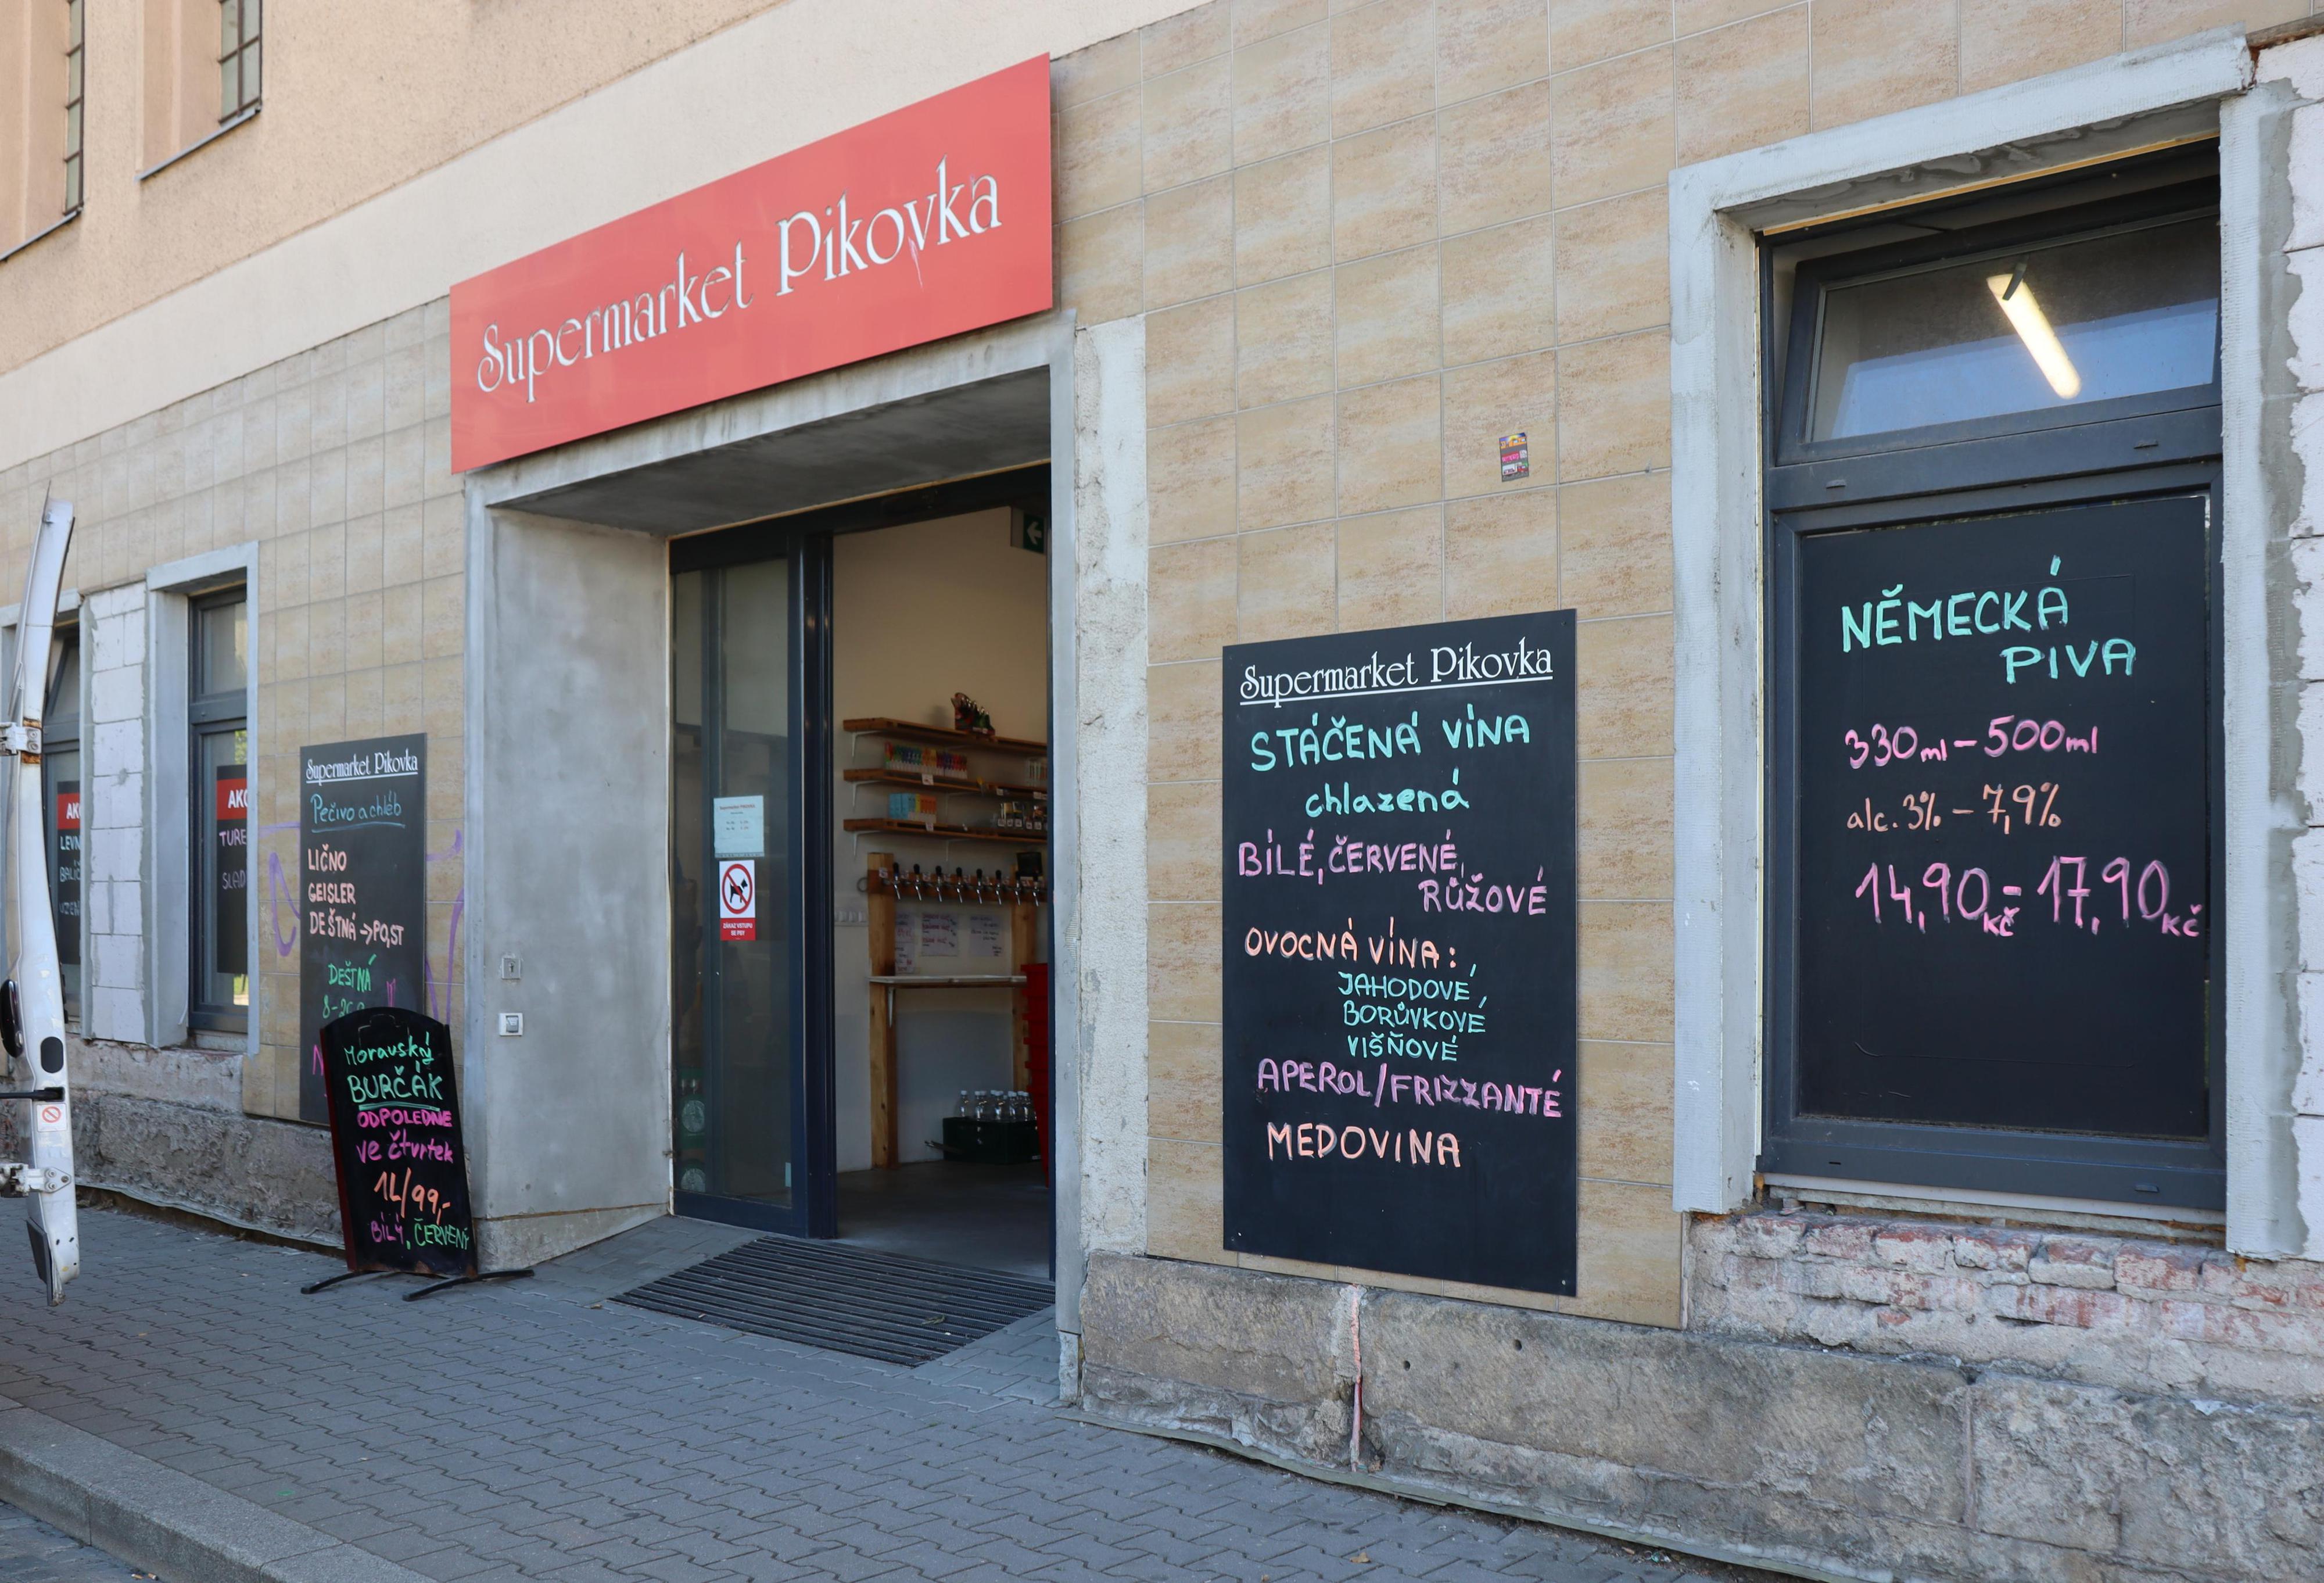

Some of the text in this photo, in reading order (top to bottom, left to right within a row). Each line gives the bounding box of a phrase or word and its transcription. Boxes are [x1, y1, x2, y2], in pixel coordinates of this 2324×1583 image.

[476, 154, 1002, 403] Supermarket Pikovka
[1841, 554, 2068, 652] NĚMECKÁ
[1240, 637, 1553, 708] Supermarket Pikovka
[1999, 638, 2136, 683] PIVA
[1251, 703, 1530, 771] STÁČENÁ VÍNA
[306, 748, 418, 786] Supermarket Pikovka
[310, 793, 355, 824] Pečivo
[1305, 767, 1470, 817] chlazená
[307, 843, 347, 872] LIČNO
[308, 882, 356, 905] GEISLER
[1418, 865, 1547, 915] RŮŽOVÉ
[1245, 917, 1358, 961] OVOCNÁ
[1338, 964, 1476, 1001] JAHODOVÉ
[1343, 996, 1487, 1033] BORŮVKOVÉ
[1347, 1032, 1458, 1061] VIŠŇOVÉ
[347, 1060, 443, 1103] BURČÁK
[357, 1108, 453, 1128] ODPOLEDNE
[356, 1129, 453, 1163] ve čtvrtek
[1267, 1122, 1461, 1168] MEDOVINA
